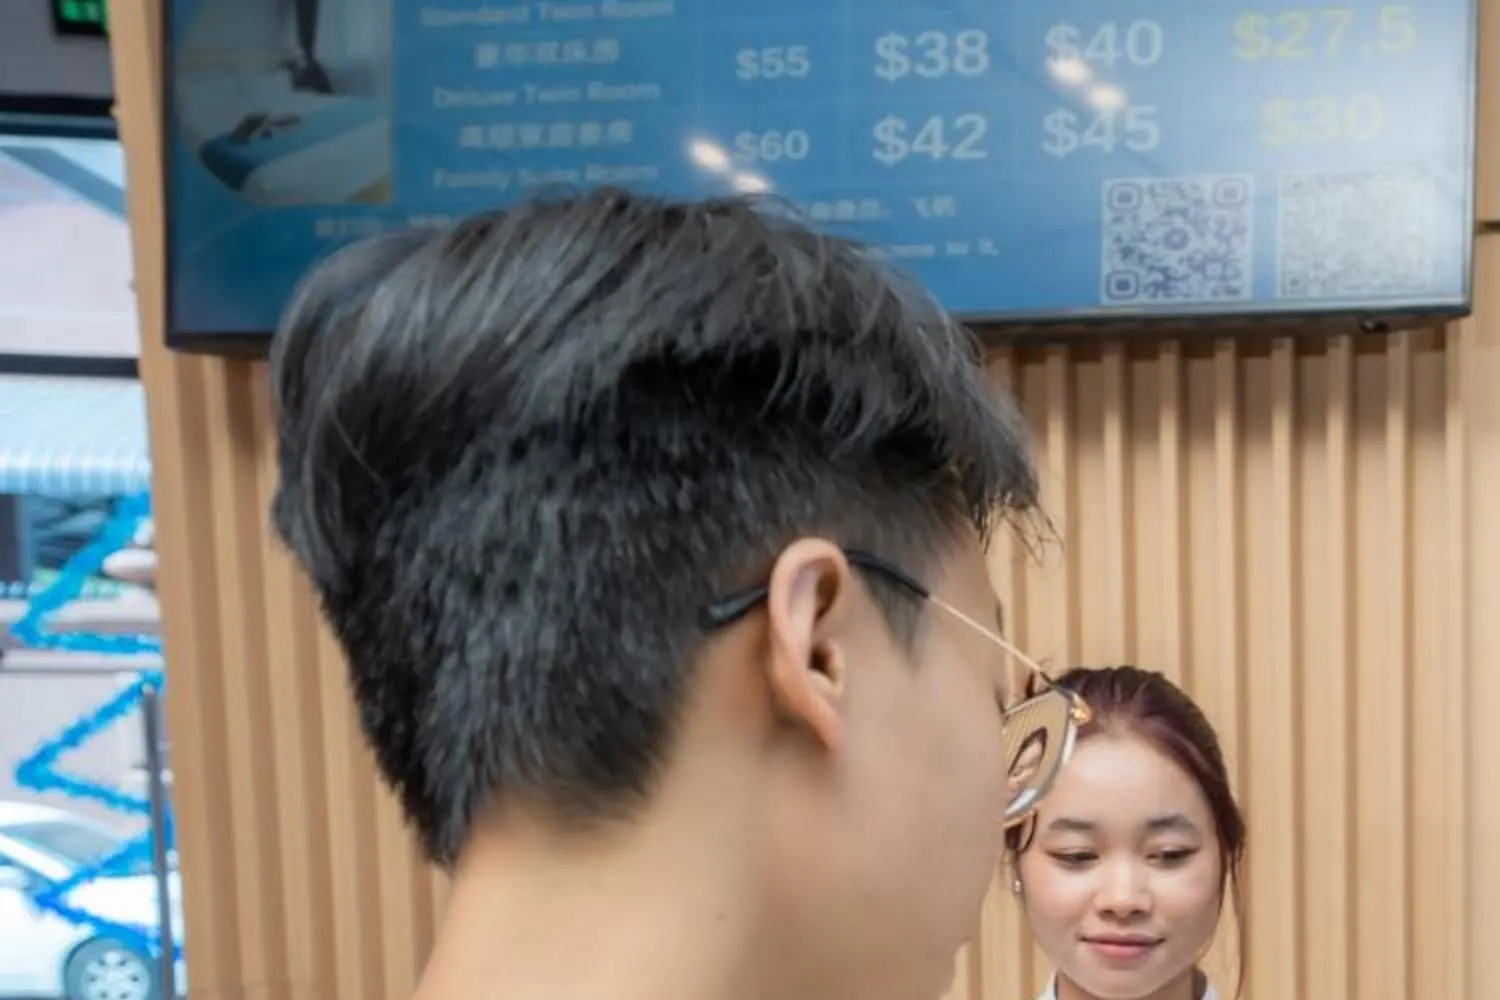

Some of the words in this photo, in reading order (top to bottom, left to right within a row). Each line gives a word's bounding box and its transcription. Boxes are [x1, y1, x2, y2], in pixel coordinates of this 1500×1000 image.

[735, 45, 811, 81] $55
[873, 29, 990, 82] $38
[1045, 20, 1163, 72] $40
[735, 130, 810, 162] $60
[872, 113, 988, 166] $42
[1041, 105, 1160, 157] $45
